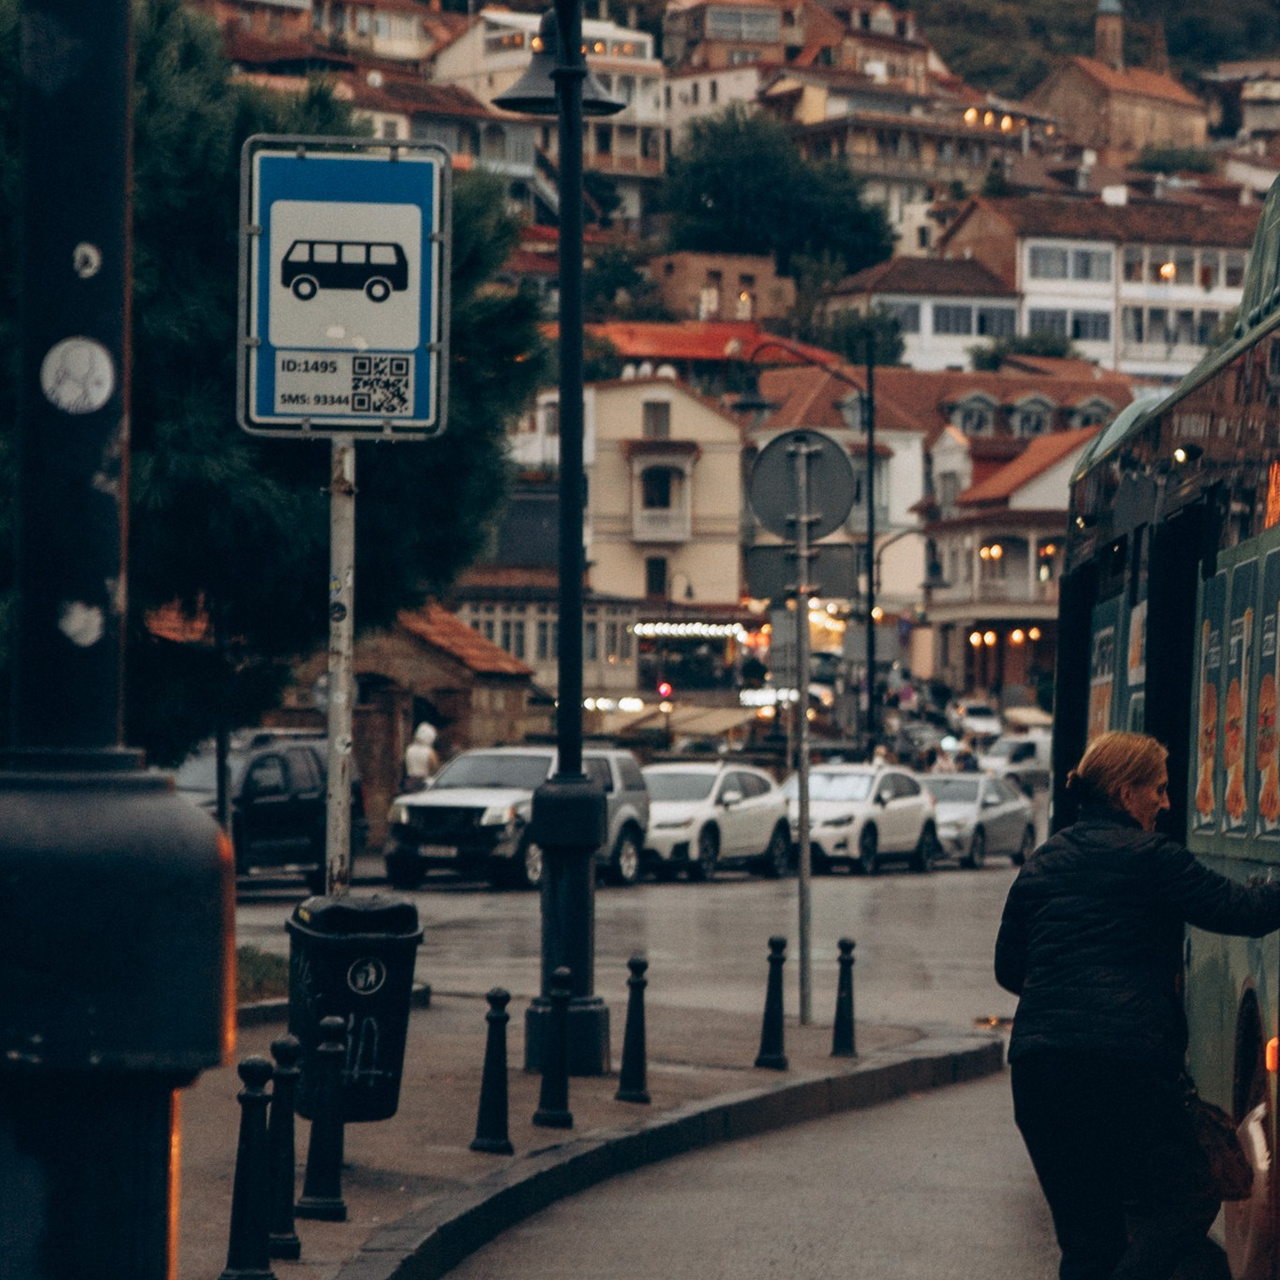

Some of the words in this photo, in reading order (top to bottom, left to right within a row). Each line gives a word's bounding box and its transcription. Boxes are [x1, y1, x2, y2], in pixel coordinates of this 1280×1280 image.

[281, 359, 338, 374] ID:1495
[280, 393, 311, 406] SMS:
[313, 394, 350, 407] 93344
